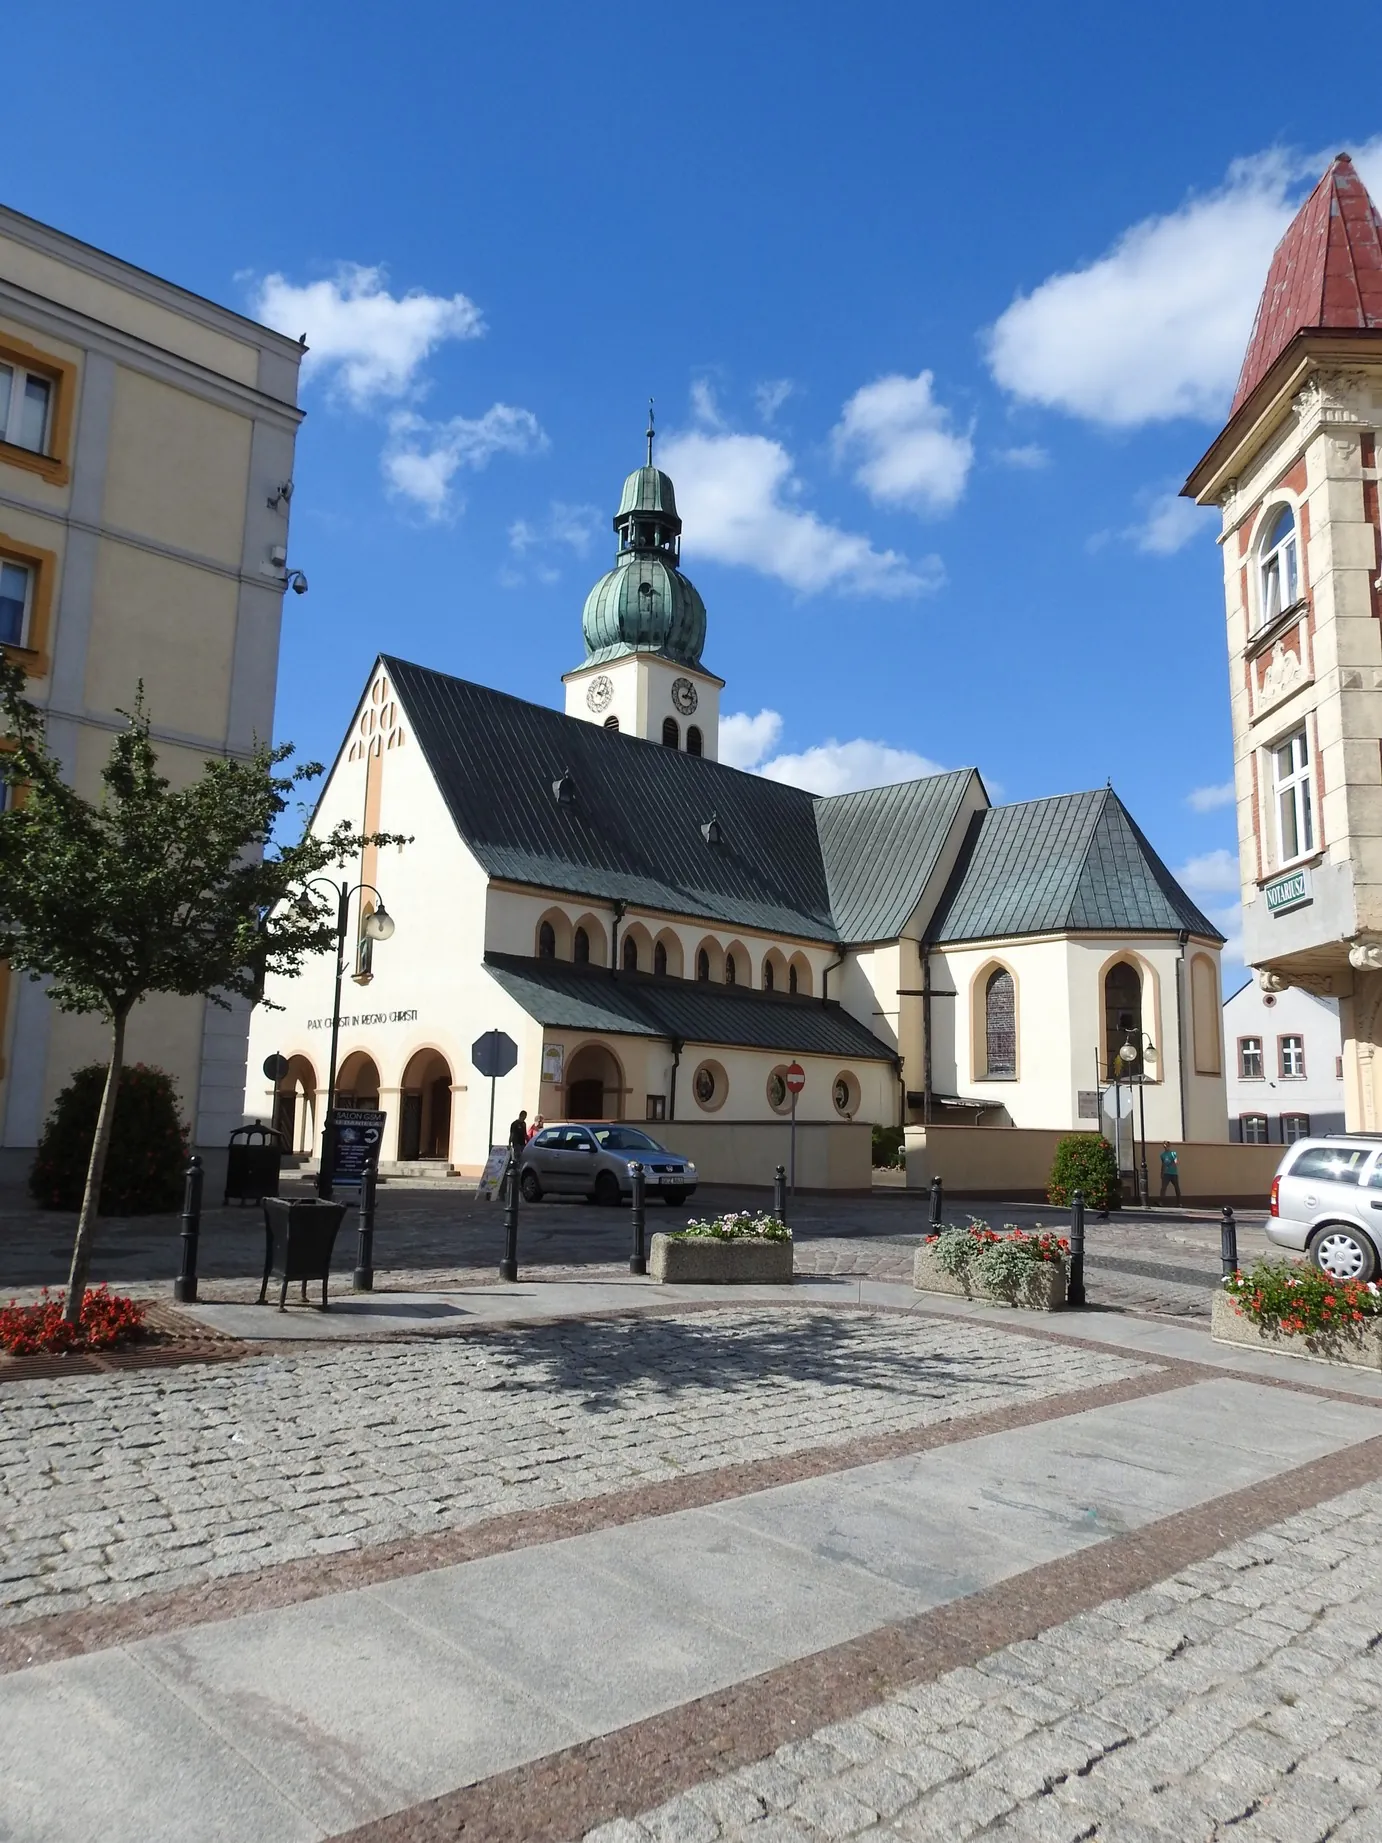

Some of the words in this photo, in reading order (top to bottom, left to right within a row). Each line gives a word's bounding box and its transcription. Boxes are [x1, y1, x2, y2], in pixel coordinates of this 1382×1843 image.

[1267, 876, 1305, 908] NOTARIUSZ
[307, 1019, 322, 1030] PAX
[352, 1015, 360, 1026] IN
[361, 1013, 387, 1026] REGNO
[389, 1010, 418, 1023] CHRISTI
[336, 1111, 362, 1120] SALON
[363, 1113, 382, 1121] GSM
